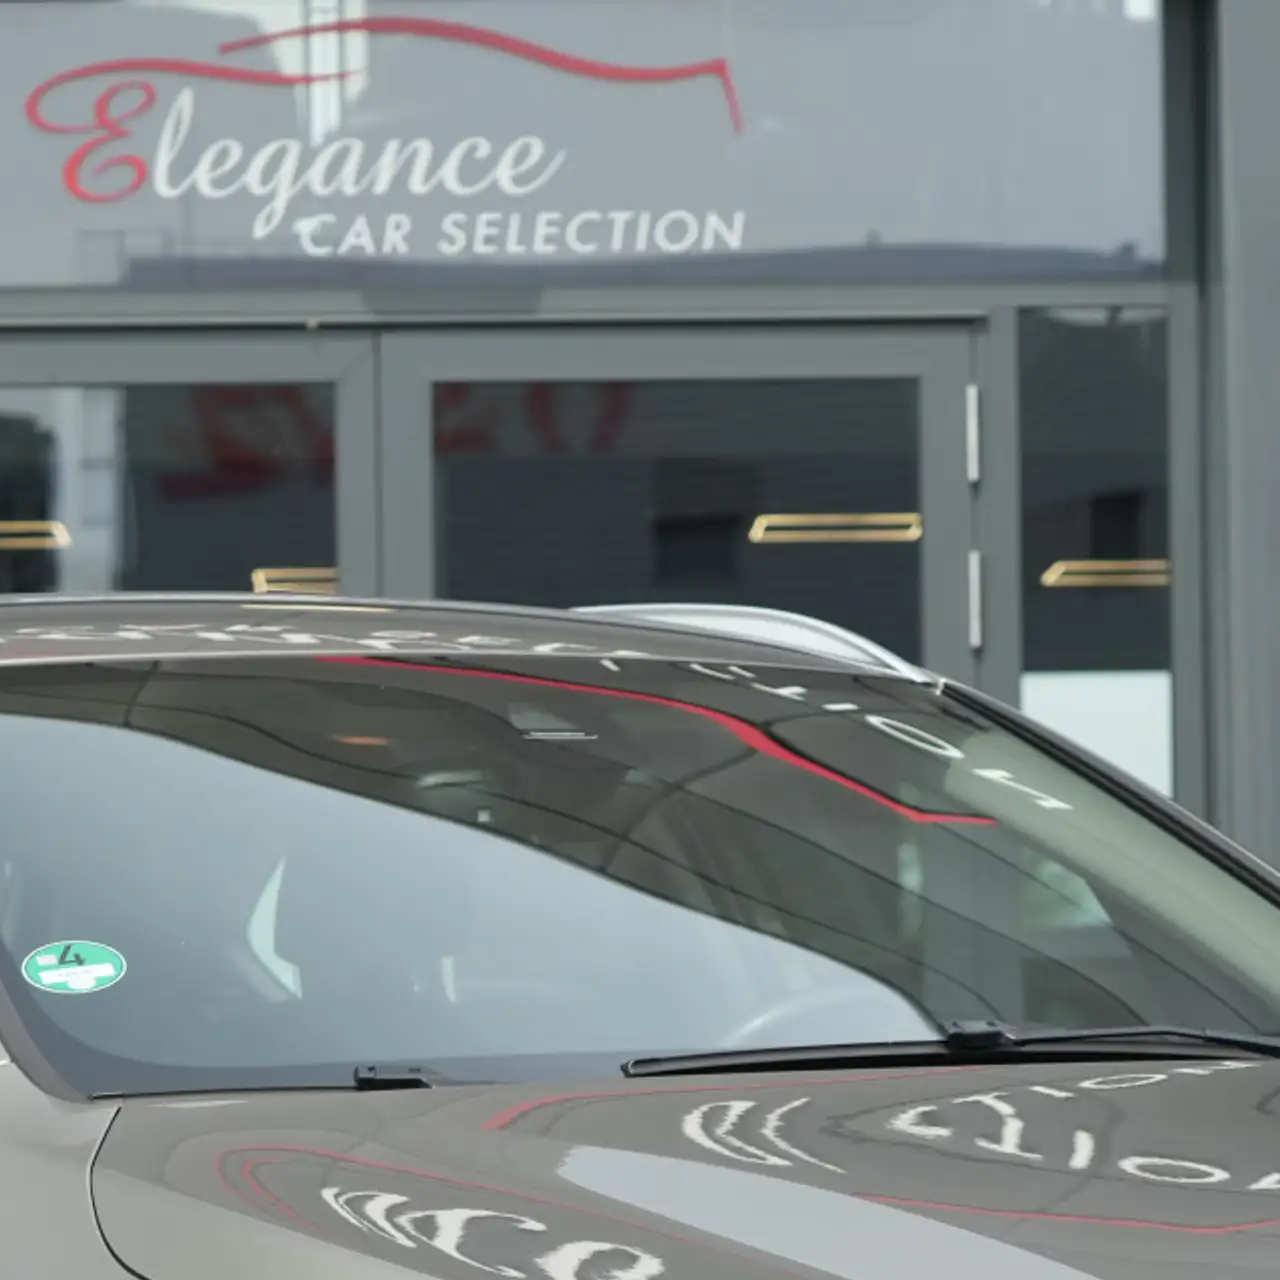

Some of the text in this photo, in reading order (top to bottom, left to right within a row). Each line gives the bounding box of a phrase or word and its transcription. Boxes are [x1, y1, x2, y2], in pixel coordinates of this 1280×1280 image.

[25, 58, 568, 240] Elegance
[294, 208, 747, 257] CAR SELECTION
[58, 943, 87, 966] 4
